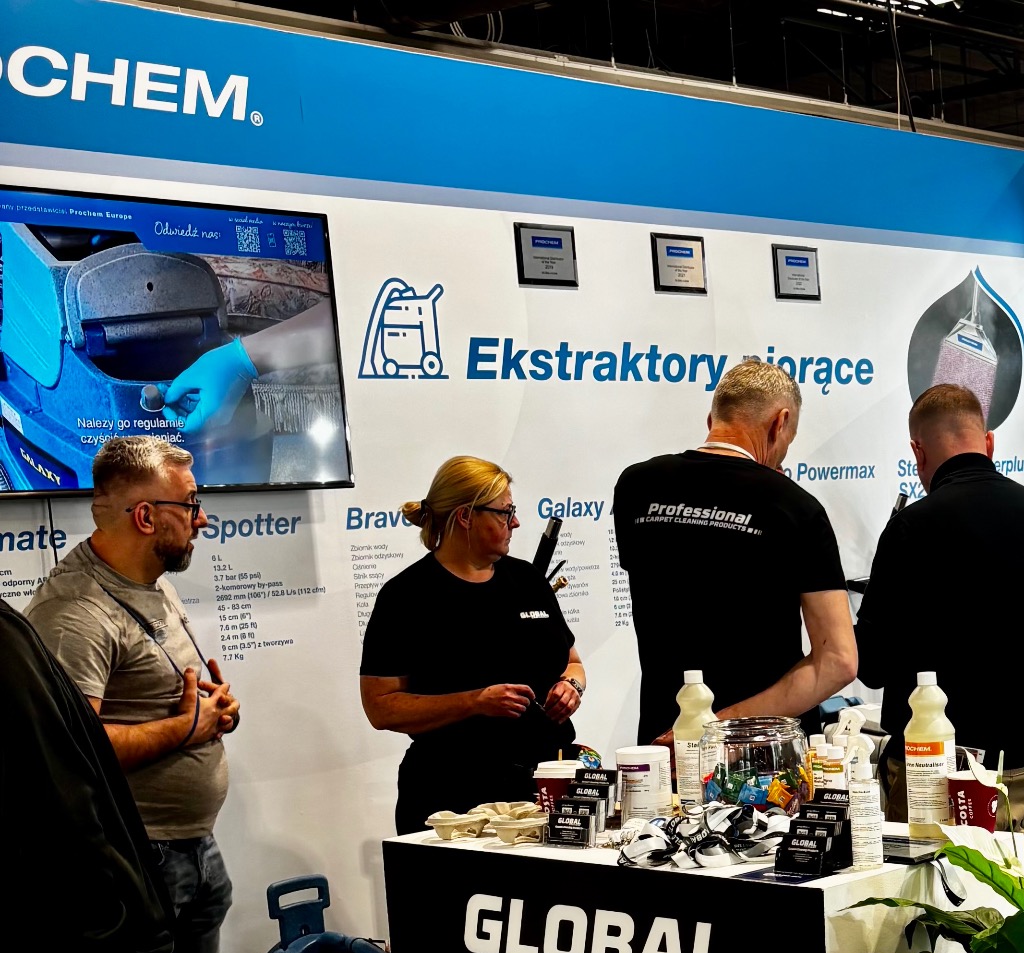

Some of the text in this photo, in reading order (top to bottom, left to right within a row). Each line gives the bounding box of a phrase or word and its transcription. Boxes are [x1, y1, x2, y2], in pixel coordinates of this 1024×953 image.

[69, 208, 103, 218] Prochem
[105, 211, 132, 221] Europe
[466, 337, 875, 396] Ekstraktory iorące
[117, 419, 131, 430] go
[133, 417, 185, 430] regularnie
[20, 447, 61, 486] GALAXY
[796, 462, 876, 481] Powermax
[537, 496, 605, 521] Galaxy
[647, 502, 753, 526] Professional
[202, 512, 302, 544] Spotter
[674, 517, 708, 526] CLEANING
[709, 520, 747, 532] PRODUCTS
[2, 576, 35, 588] odporny
[250, 571, 262, 580] psi)
[215, 581, 283, 592] 2-komorowy by-pass
[584, 772, 608, 780] GLOBAL
[576, 787, 599, 796] GLOBAL
[823, 793, 849, 801] GLOBAL
[558, 817, 582, 826] GLOBAL
[791, 839, 818, 848] GLOBAL
